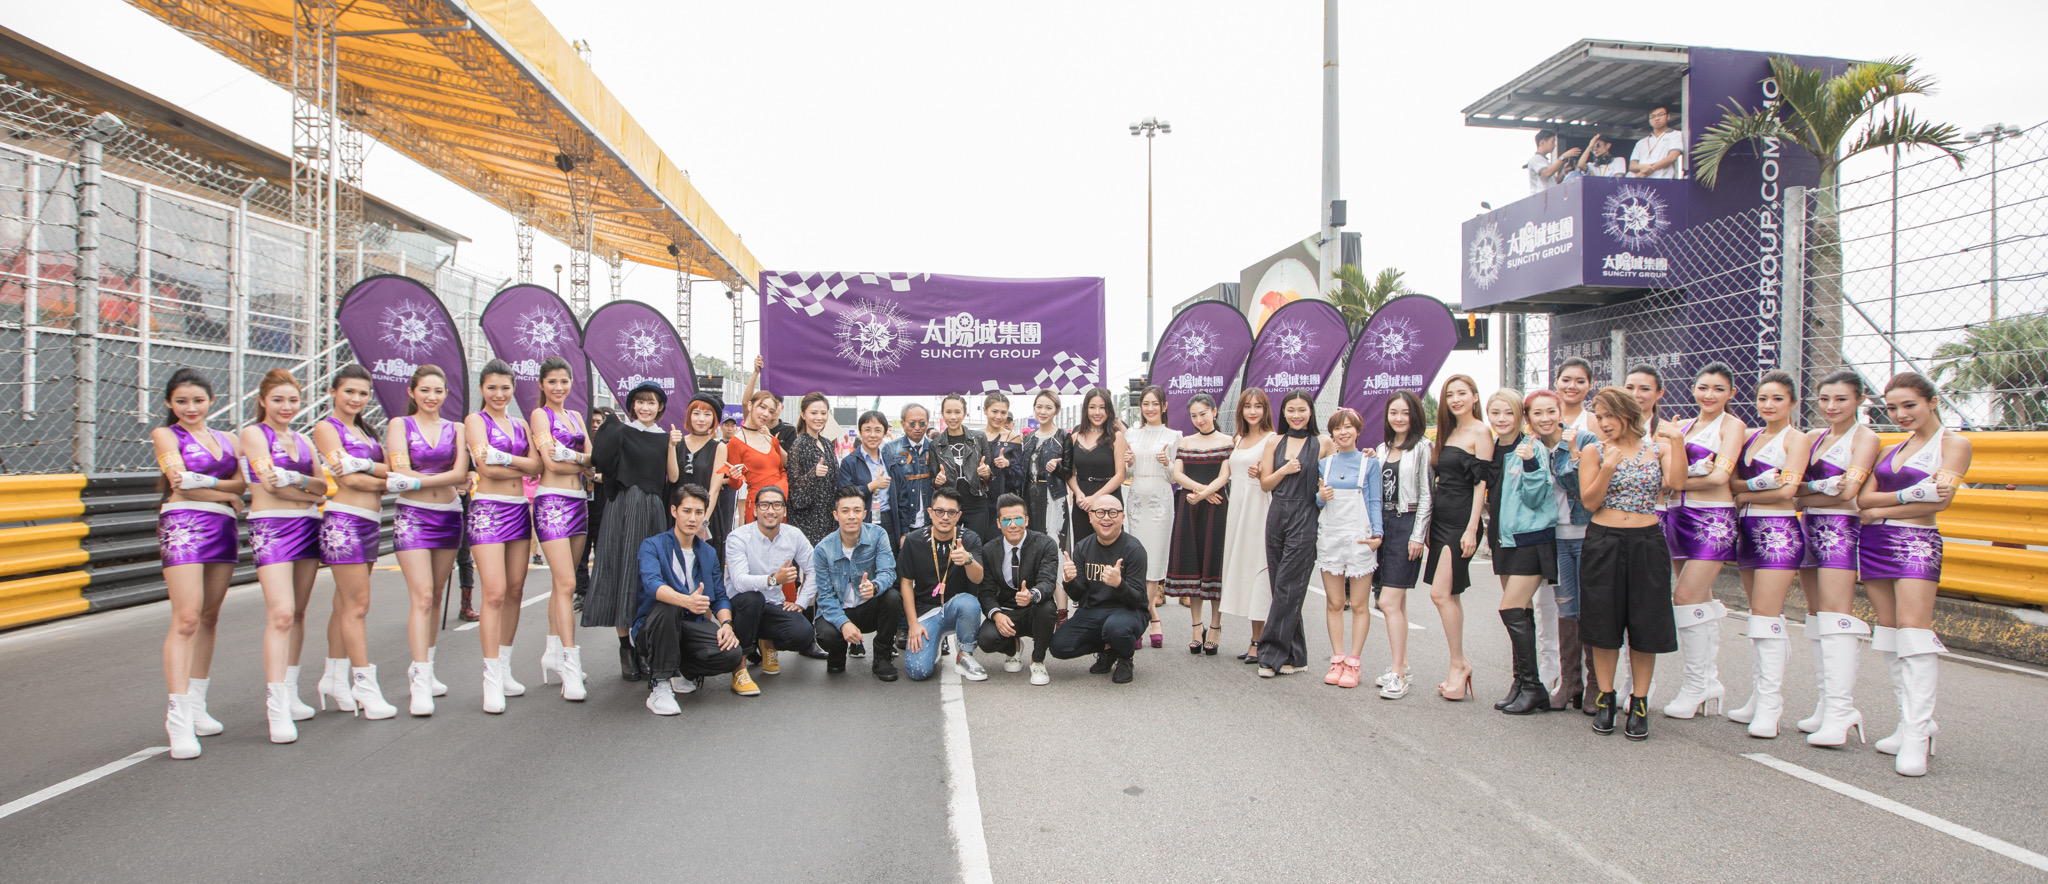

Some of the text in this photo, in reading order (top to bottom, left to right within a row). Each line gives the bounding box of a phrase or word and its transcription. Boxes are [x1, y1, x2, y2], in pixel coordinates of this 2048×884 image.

[1507, 216, 1573, 257] 太陽城集團
[1507, 242, 1573, 269] SUNCITY GROUP
[1602, 252, 1668, 271] 太陽城集團
[920, 312, 1041, 347] 太陽城集團
[920, 349, 1041, 359] SUNCITY GROUP
[372, 358, 418, 377] 太陽城
[371, 373, 410, 383] SUNCITY
[1168, 373, 1224, 389] 太陽城集團
[1264, 371, 1320, 388] 太陽城集團
[1363, 372, 1423, 389] 太陽城集團
